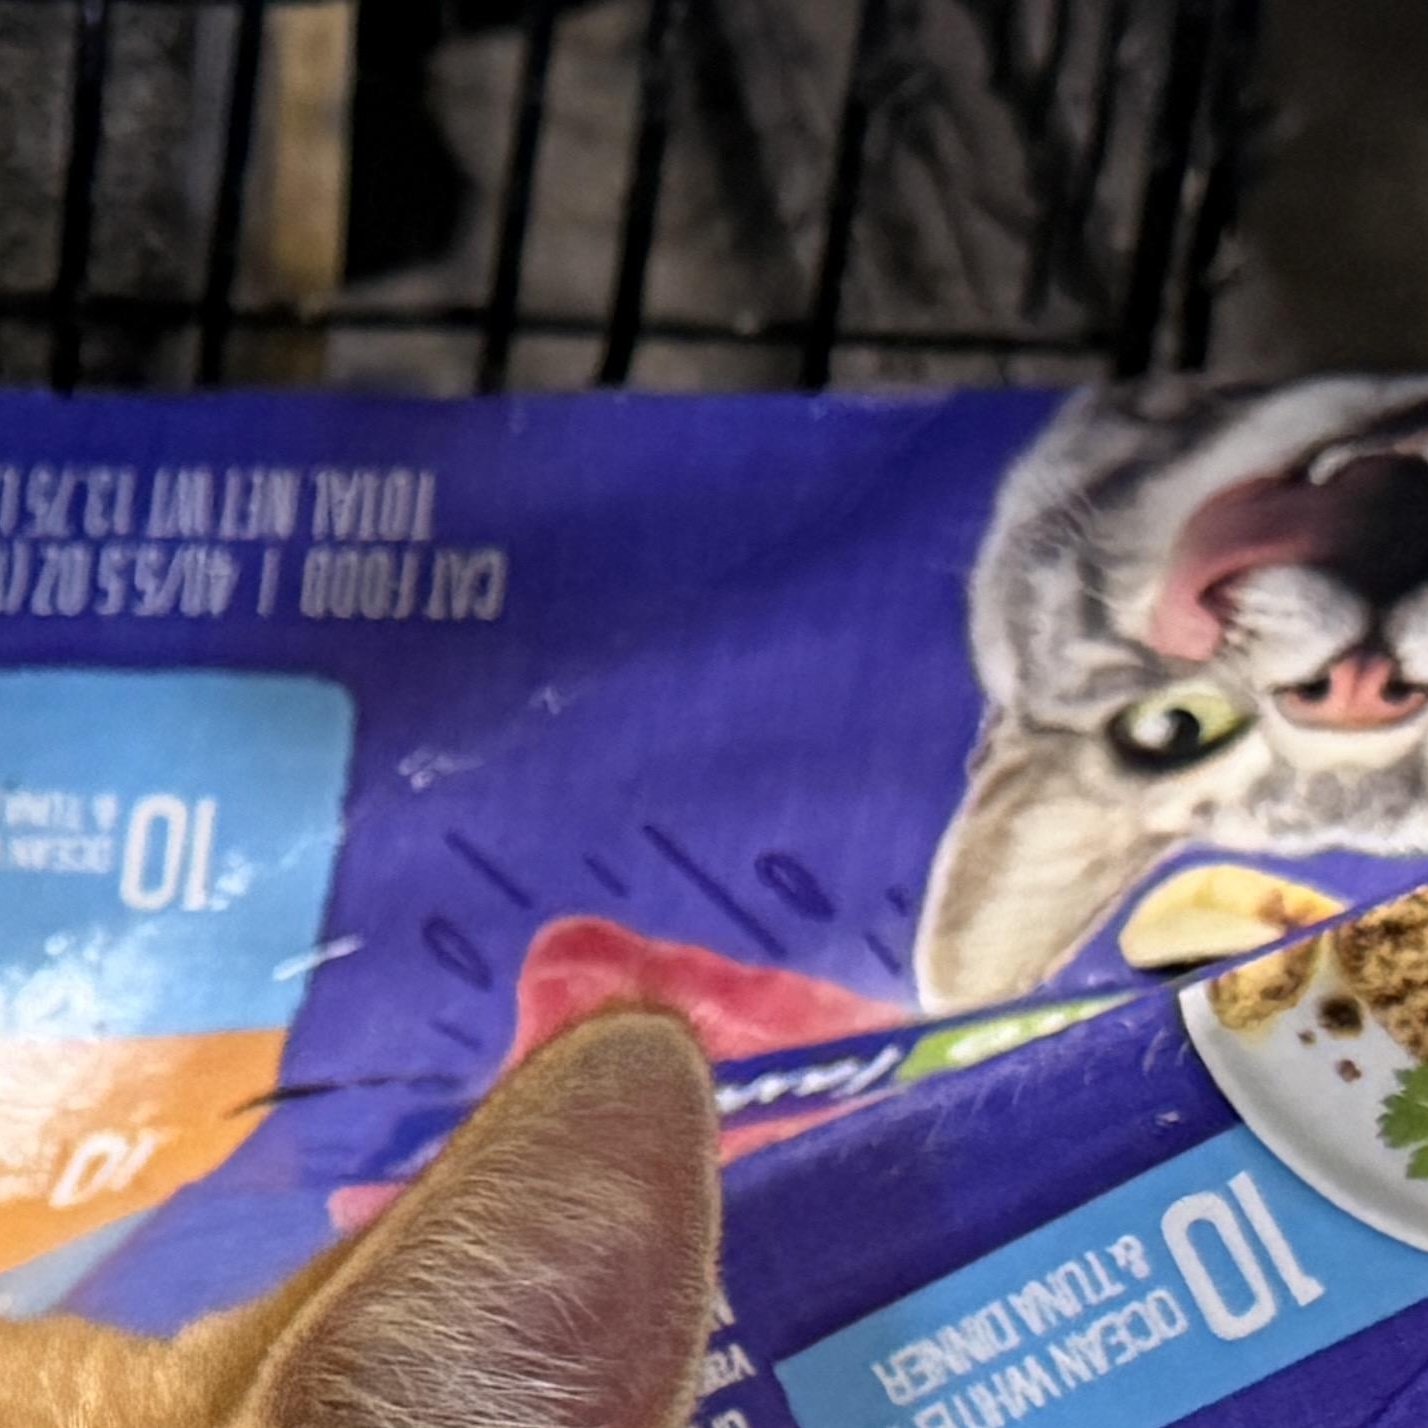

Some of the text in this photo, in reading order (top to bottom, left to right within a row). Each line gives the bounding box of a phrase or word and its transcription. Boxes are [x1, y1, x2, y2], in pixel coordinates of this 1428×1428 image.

[149, 467, 214, 540] WT
[219, 467, 302, 538] NET
[312, 468, 436, 541] TOTAL
[31, 540, 92, 617] OZ
[299, 541, 419, 618] FOOD
[425, 546, 509, 622] CAT
[119, 792, 218, 912] 10
[49, 1128, 158, 1209] 10
[1158, 1168, 1325, 1343] 10
[869, 1234, 1151, 1405] & TUNA DINNER
[1047, 1286, 1188, 1391] OCEAN
